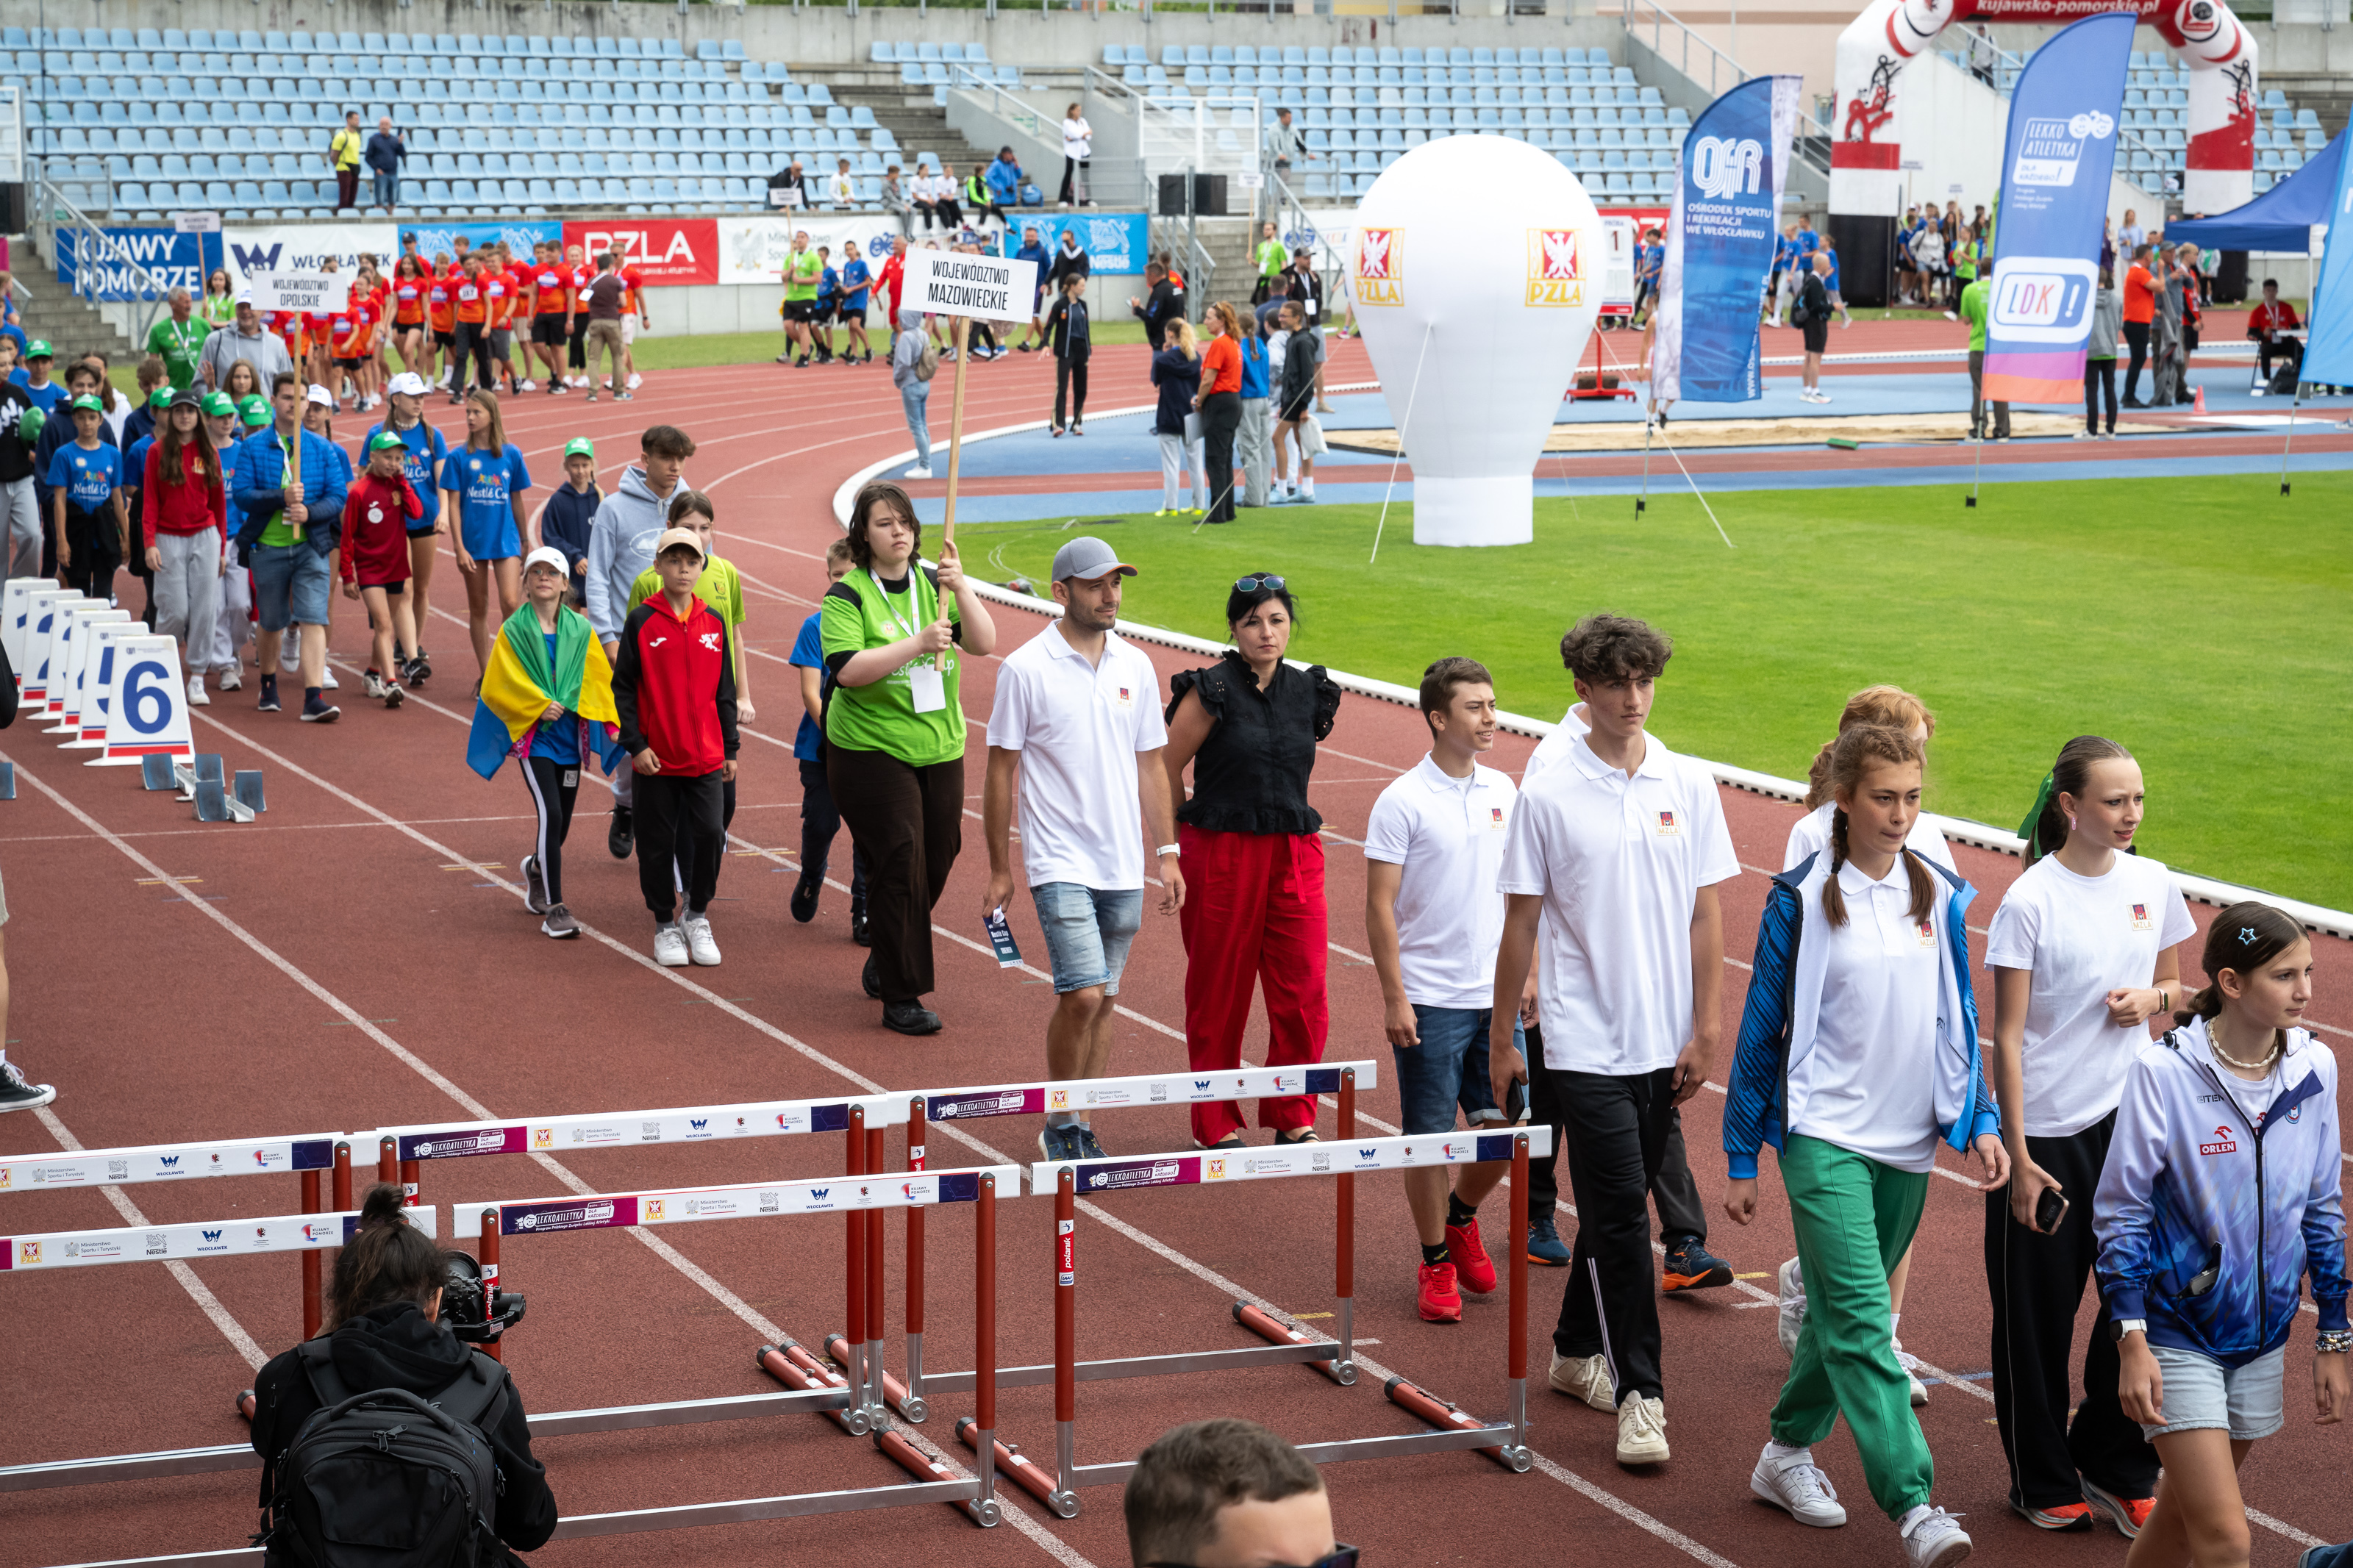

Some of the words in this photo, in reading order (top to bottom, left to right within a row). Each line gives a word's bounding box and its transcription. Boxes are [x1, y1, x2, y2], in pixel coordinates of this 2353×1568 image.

[1977, 0, 2160, 13] kujawsko-pomorskie.pl
[2029, 123, 2065, 139] LEKKO
[2024, 140, 2076, 157] ATLETYKA
[1688, 202, 1733, 215] OŚRODEK
[1735, 206, 1771, 218] SPORTU
[1692, 215, 1742, 226] REKREACJI
[1686, 225, 1701, 234] WE
[1703, 226, 1765, 239] WŁOCŁAWKU
[74, 235, 178, 262] KUJAWY
[585, 230, 696, 265] PZLA
[1612, 231, 1618, 251] 1
[75, 266, 200, 293] POMORZE
[932, 260, 1010, 285] WOJEWÓDZTWO
[273, 279, 329, 291] WOJEWÓDZTWO
[1530, 282, 1580, 303] PZLA
[280, 294, 320, 307] OPOLSKIE
[928, 283, 1008, 310] MAZOWIECKIE
[467, 487, 493, 498] Nestlé
[123, 661, 172, 734] 6
[957, 1100, 998, 1111] LEKKOATLETYKA
[432, 1139, 476, 1152] LEKKOATLETYKA
[2202, 1143, 2234, 1153] ORLEN
[1108, 1170, 1151, 1181] LEKKOATLETYKA
[537, 1211, 583, 1224] LEKKOATLETYKA
[1063, 1237, 1072, 1268] polanik
